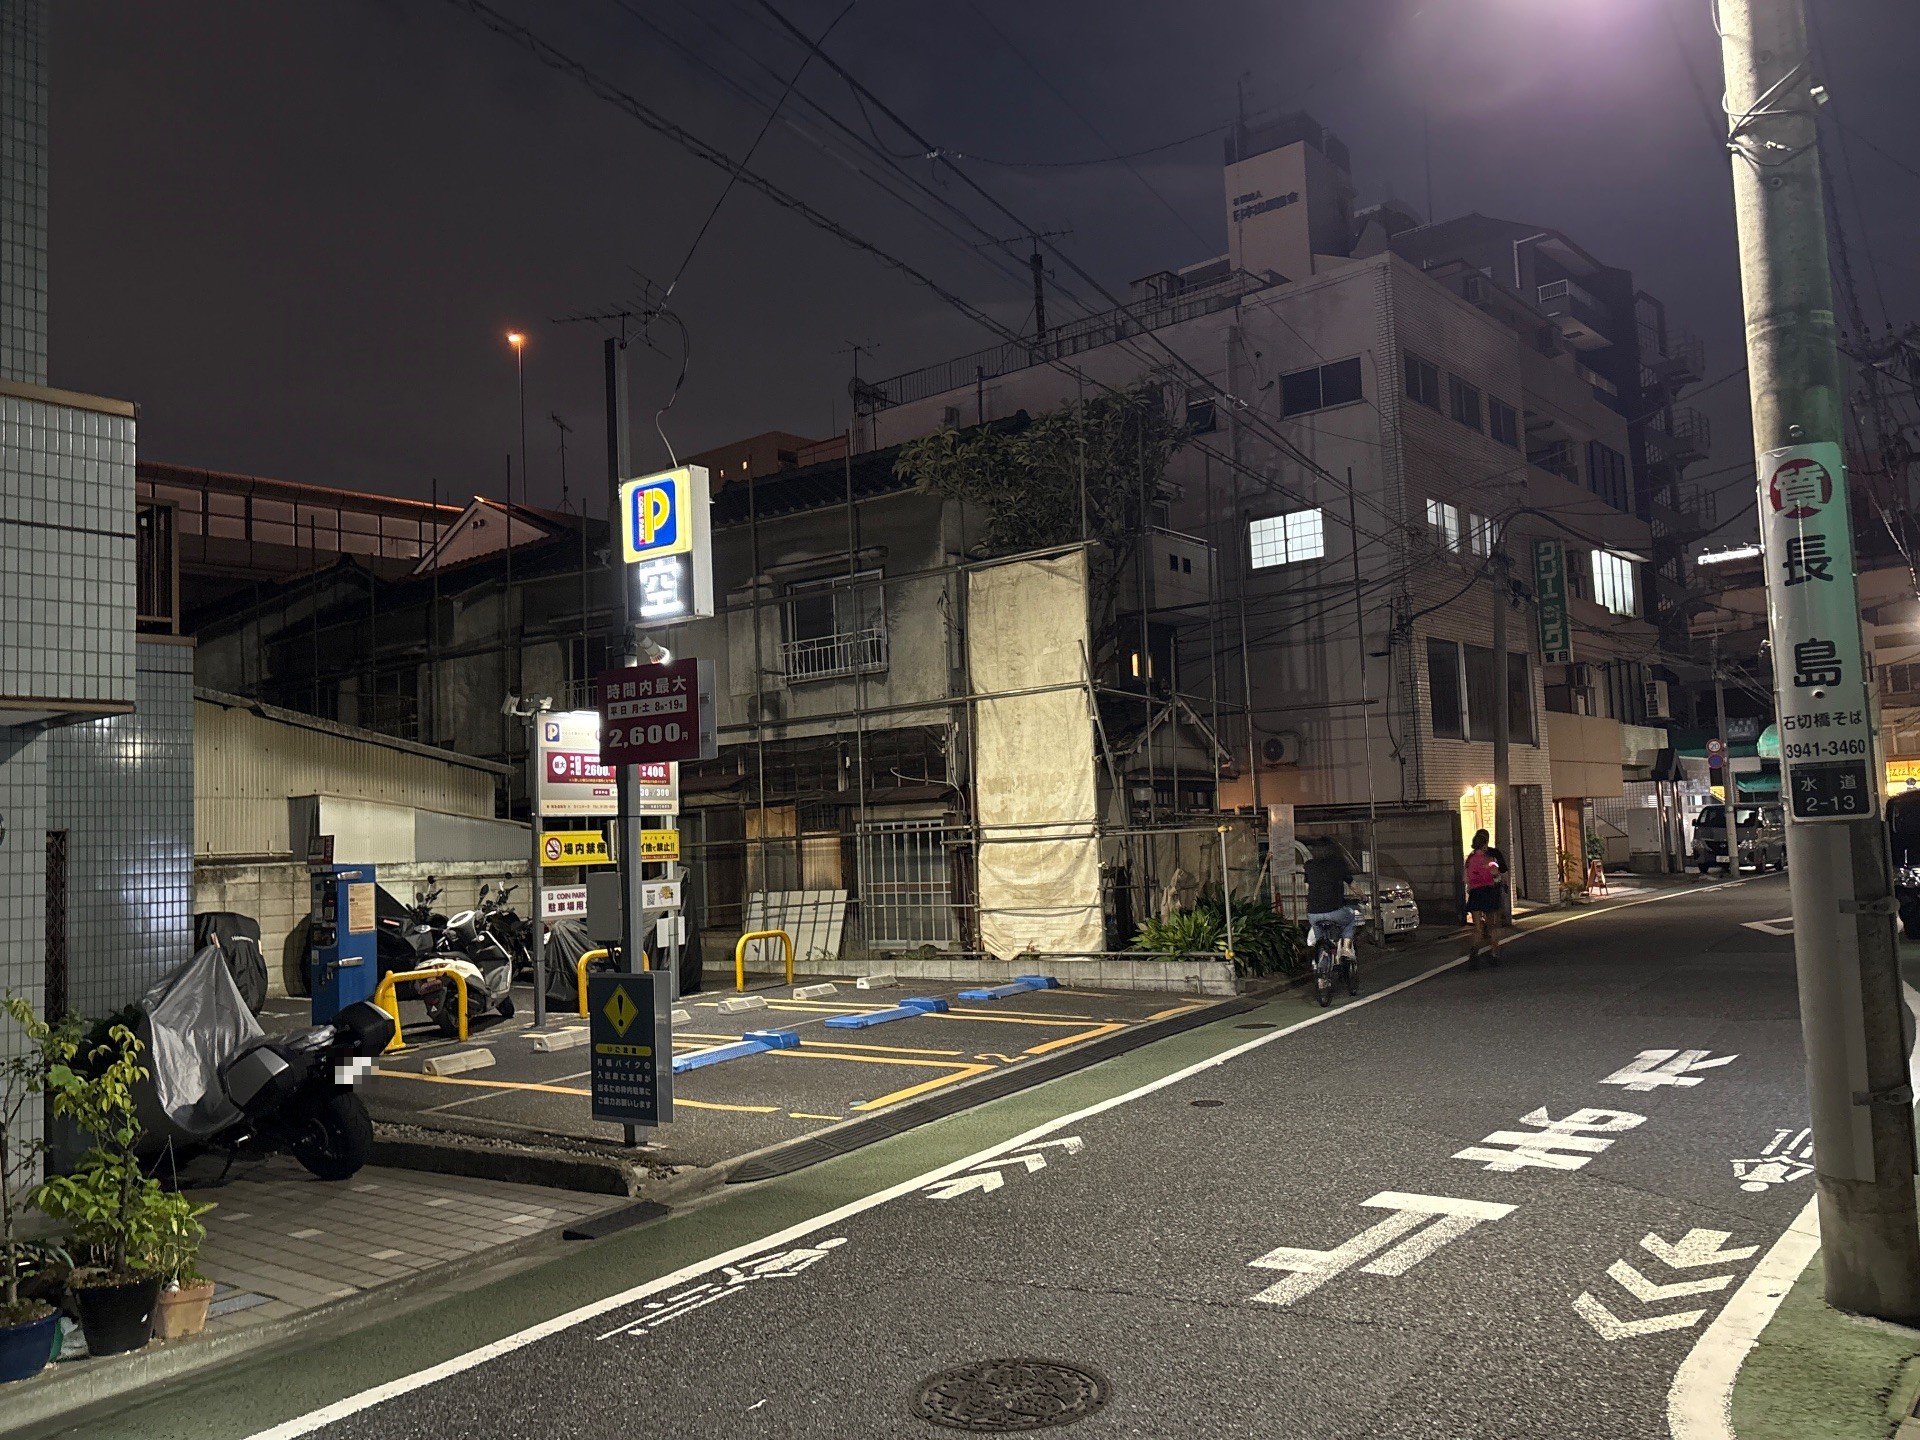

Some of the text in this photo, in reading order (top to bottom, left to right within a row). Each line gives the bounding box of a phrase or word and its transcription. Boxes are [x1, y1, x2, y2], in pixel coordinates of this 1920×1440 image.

[1782, 534, 1843, 688] 長島
[606, 675, 687, 700] 時間内最大
[610, 705, 627, 716] 平日
[1783, 710, 1863, 732] 石切橋そば
[1710, 741, 1721, 750] 20
[1786, 739, 1866, 759] 3941-3460
[1801, 774, 1857, 792] 水道
[1806, 796, 1856, 812] 2-13
[564, 842, 606, 855] 場内禁煙
[548, 901, 587, 912] 駐車場用
